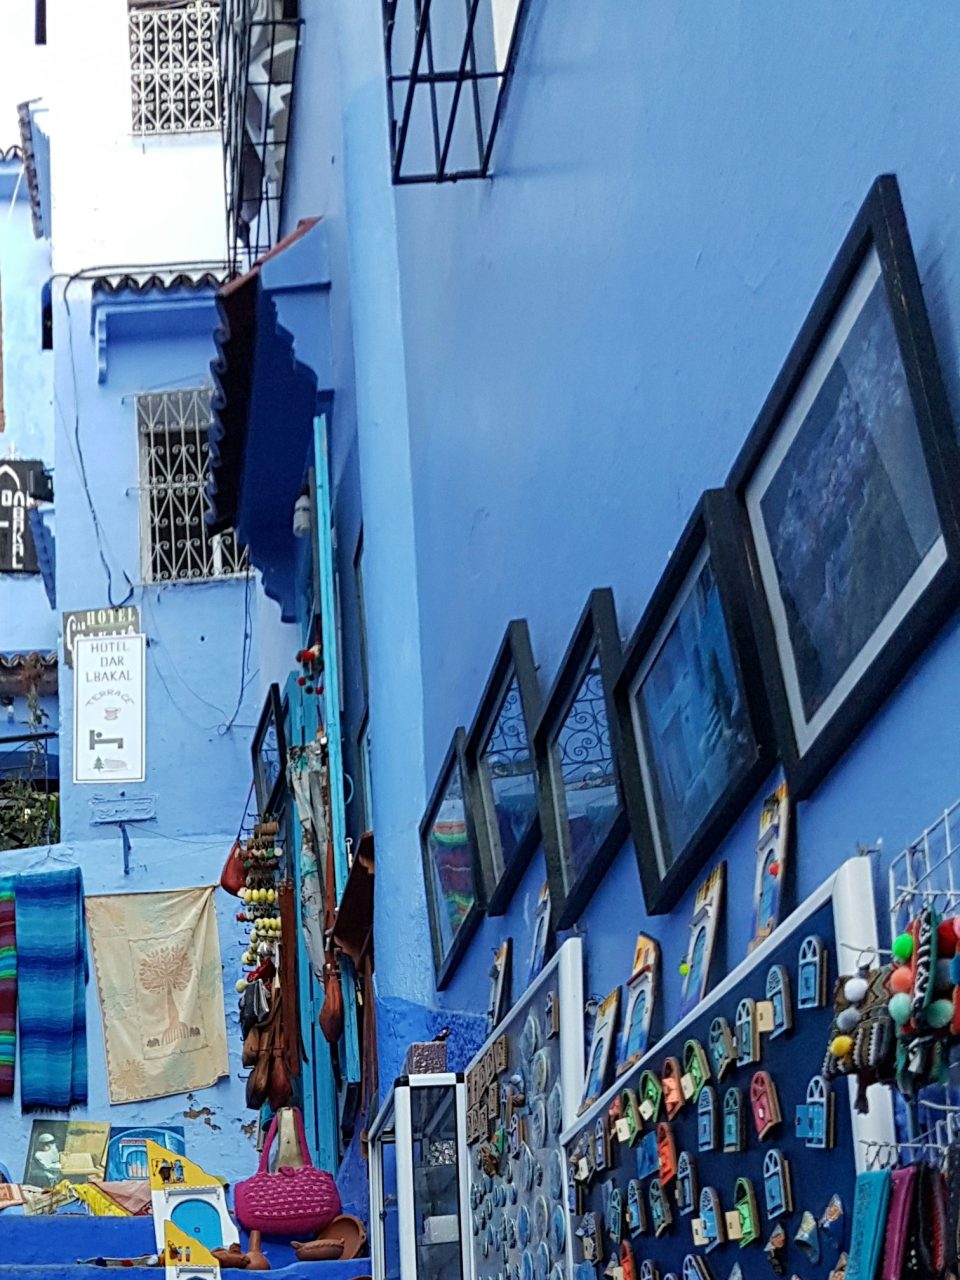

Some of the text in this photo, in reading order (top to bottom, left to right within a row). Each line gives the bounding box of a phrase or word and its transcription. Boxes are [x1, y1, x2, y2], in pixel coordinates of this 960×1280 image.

[86, 607, 135, 625] HOTEL
[91, 641, 130, 653] HOTEL
[100, 656, 124, 667] DAR
